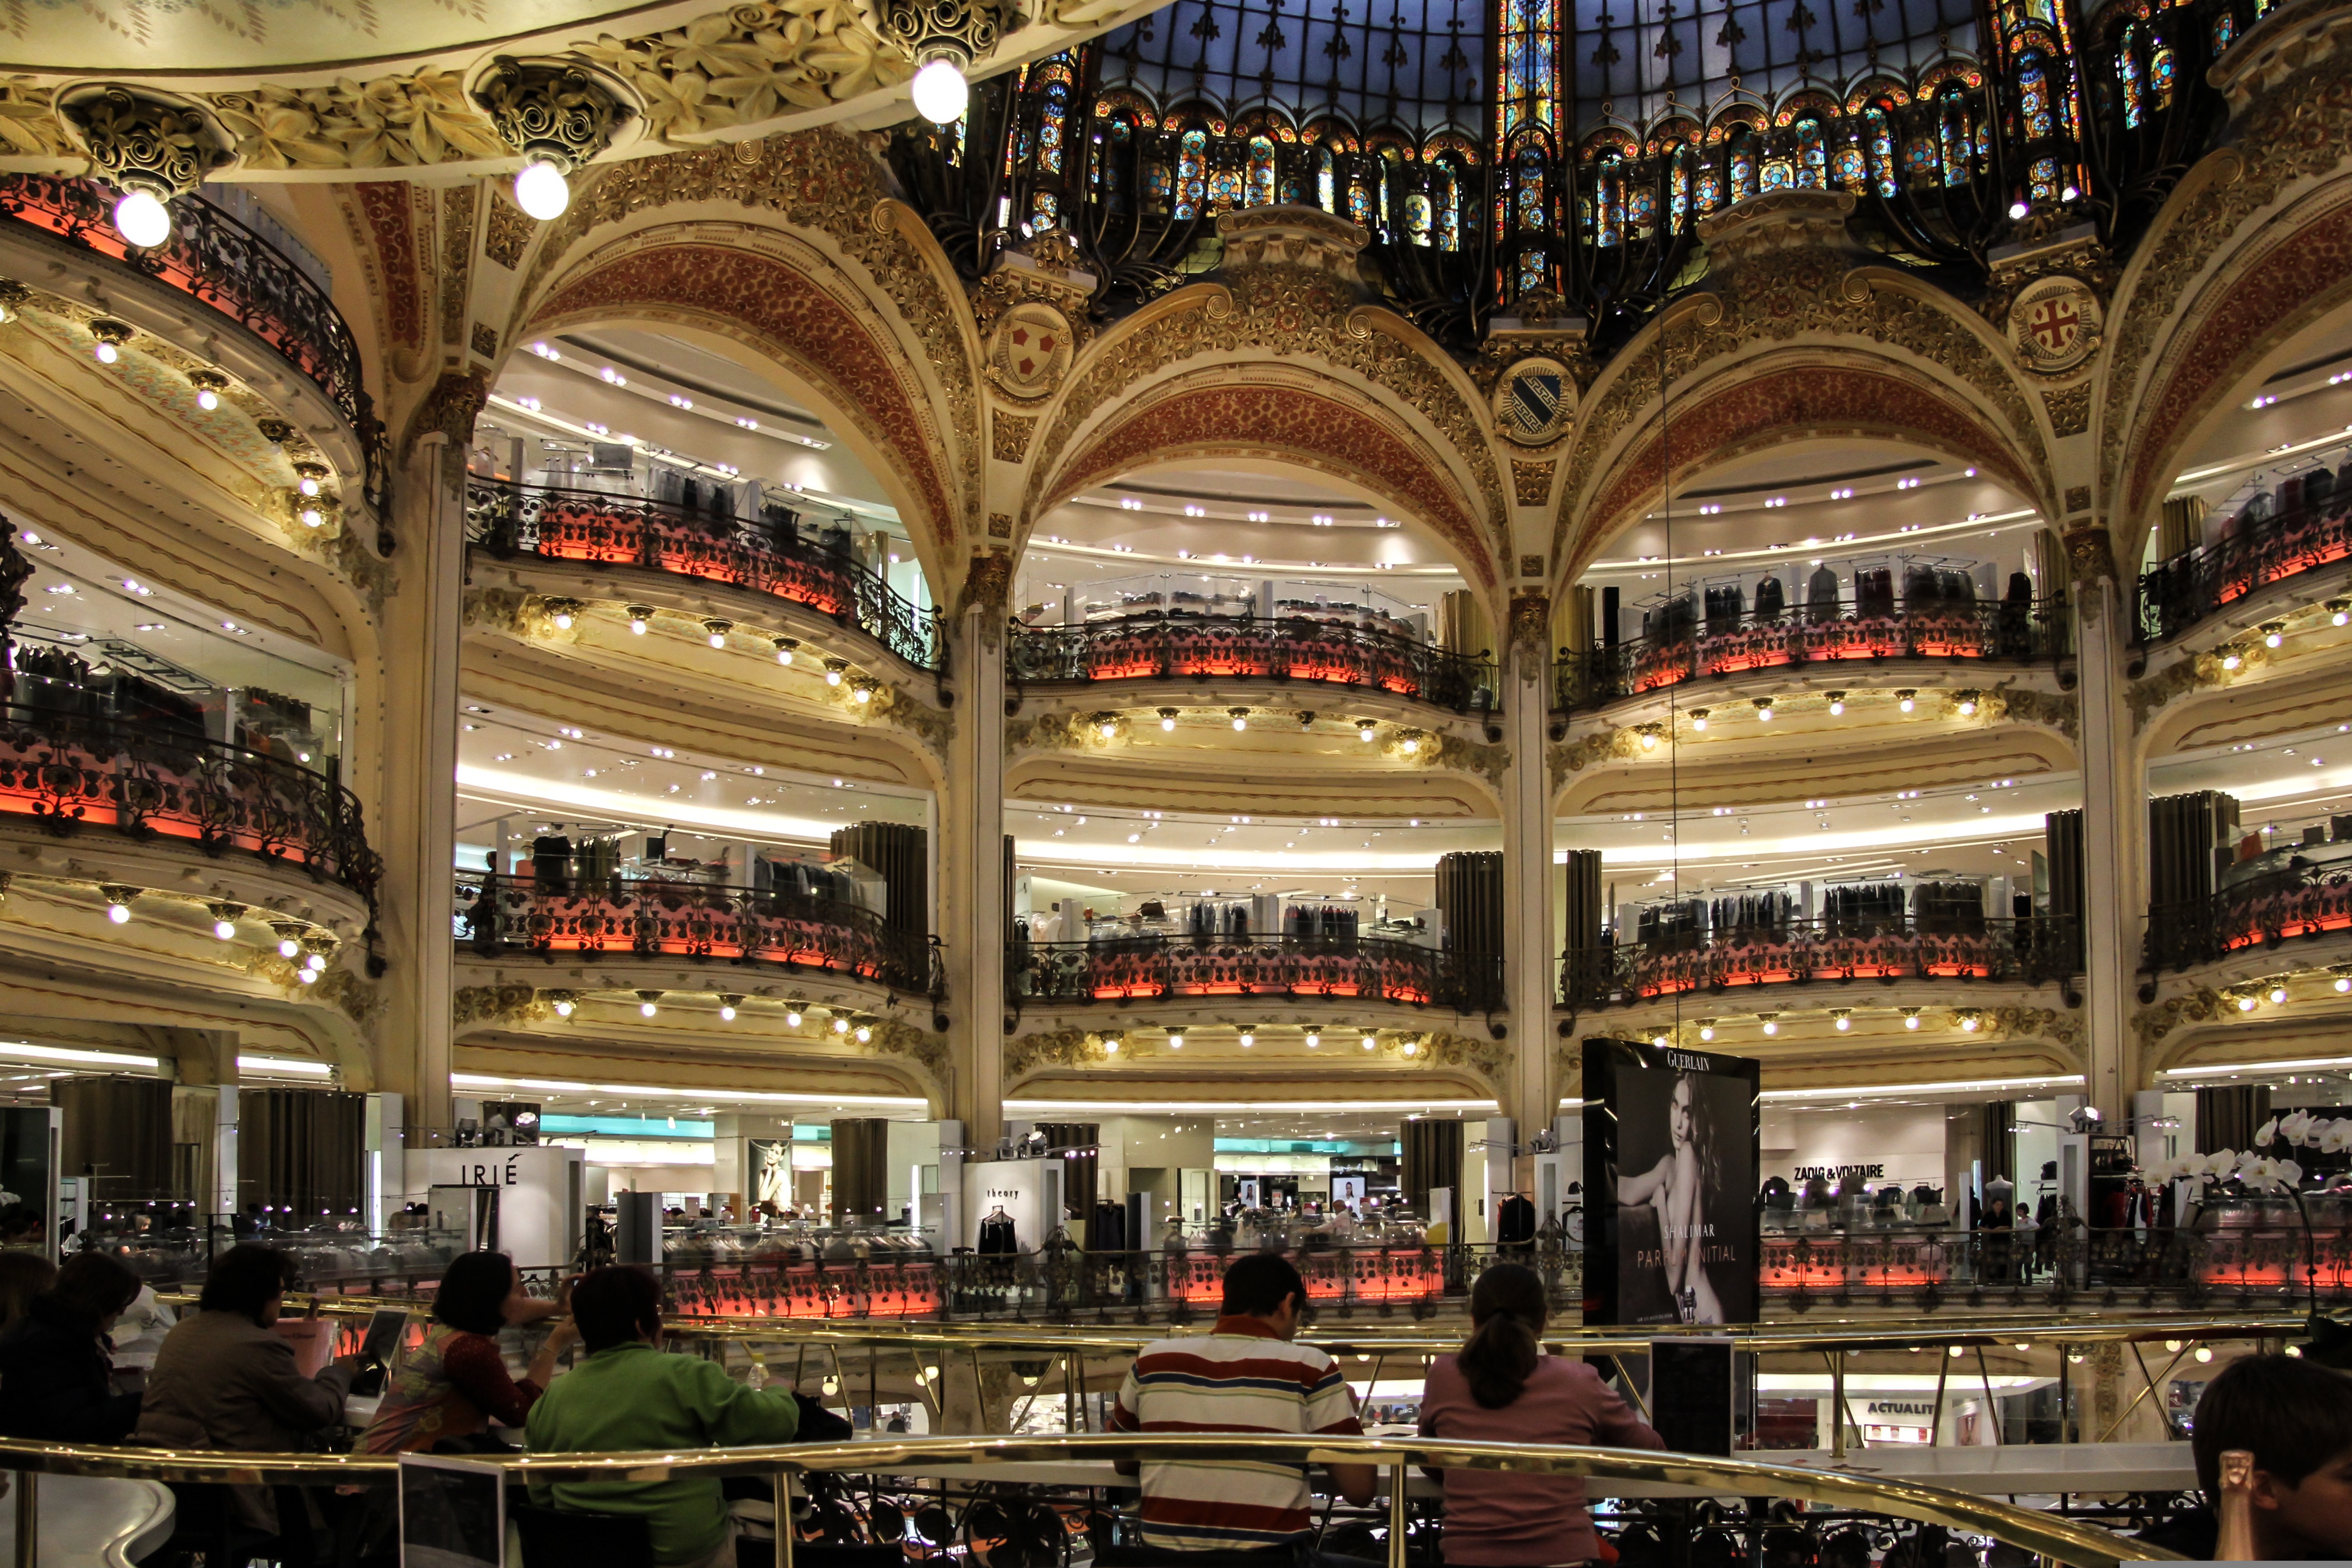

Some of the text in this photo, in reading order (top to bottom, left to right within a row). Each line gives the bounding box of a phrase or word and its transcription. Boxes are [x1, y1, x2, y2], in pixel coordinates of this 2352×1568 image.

[1667, 1050, 1710, 1071] GUERLAIN
[1827, 1168, 1835, 1179] &
[987, 1188, 1019, 1200] theory
[1664, 1224, 1715, 1239] SHALIMAR
